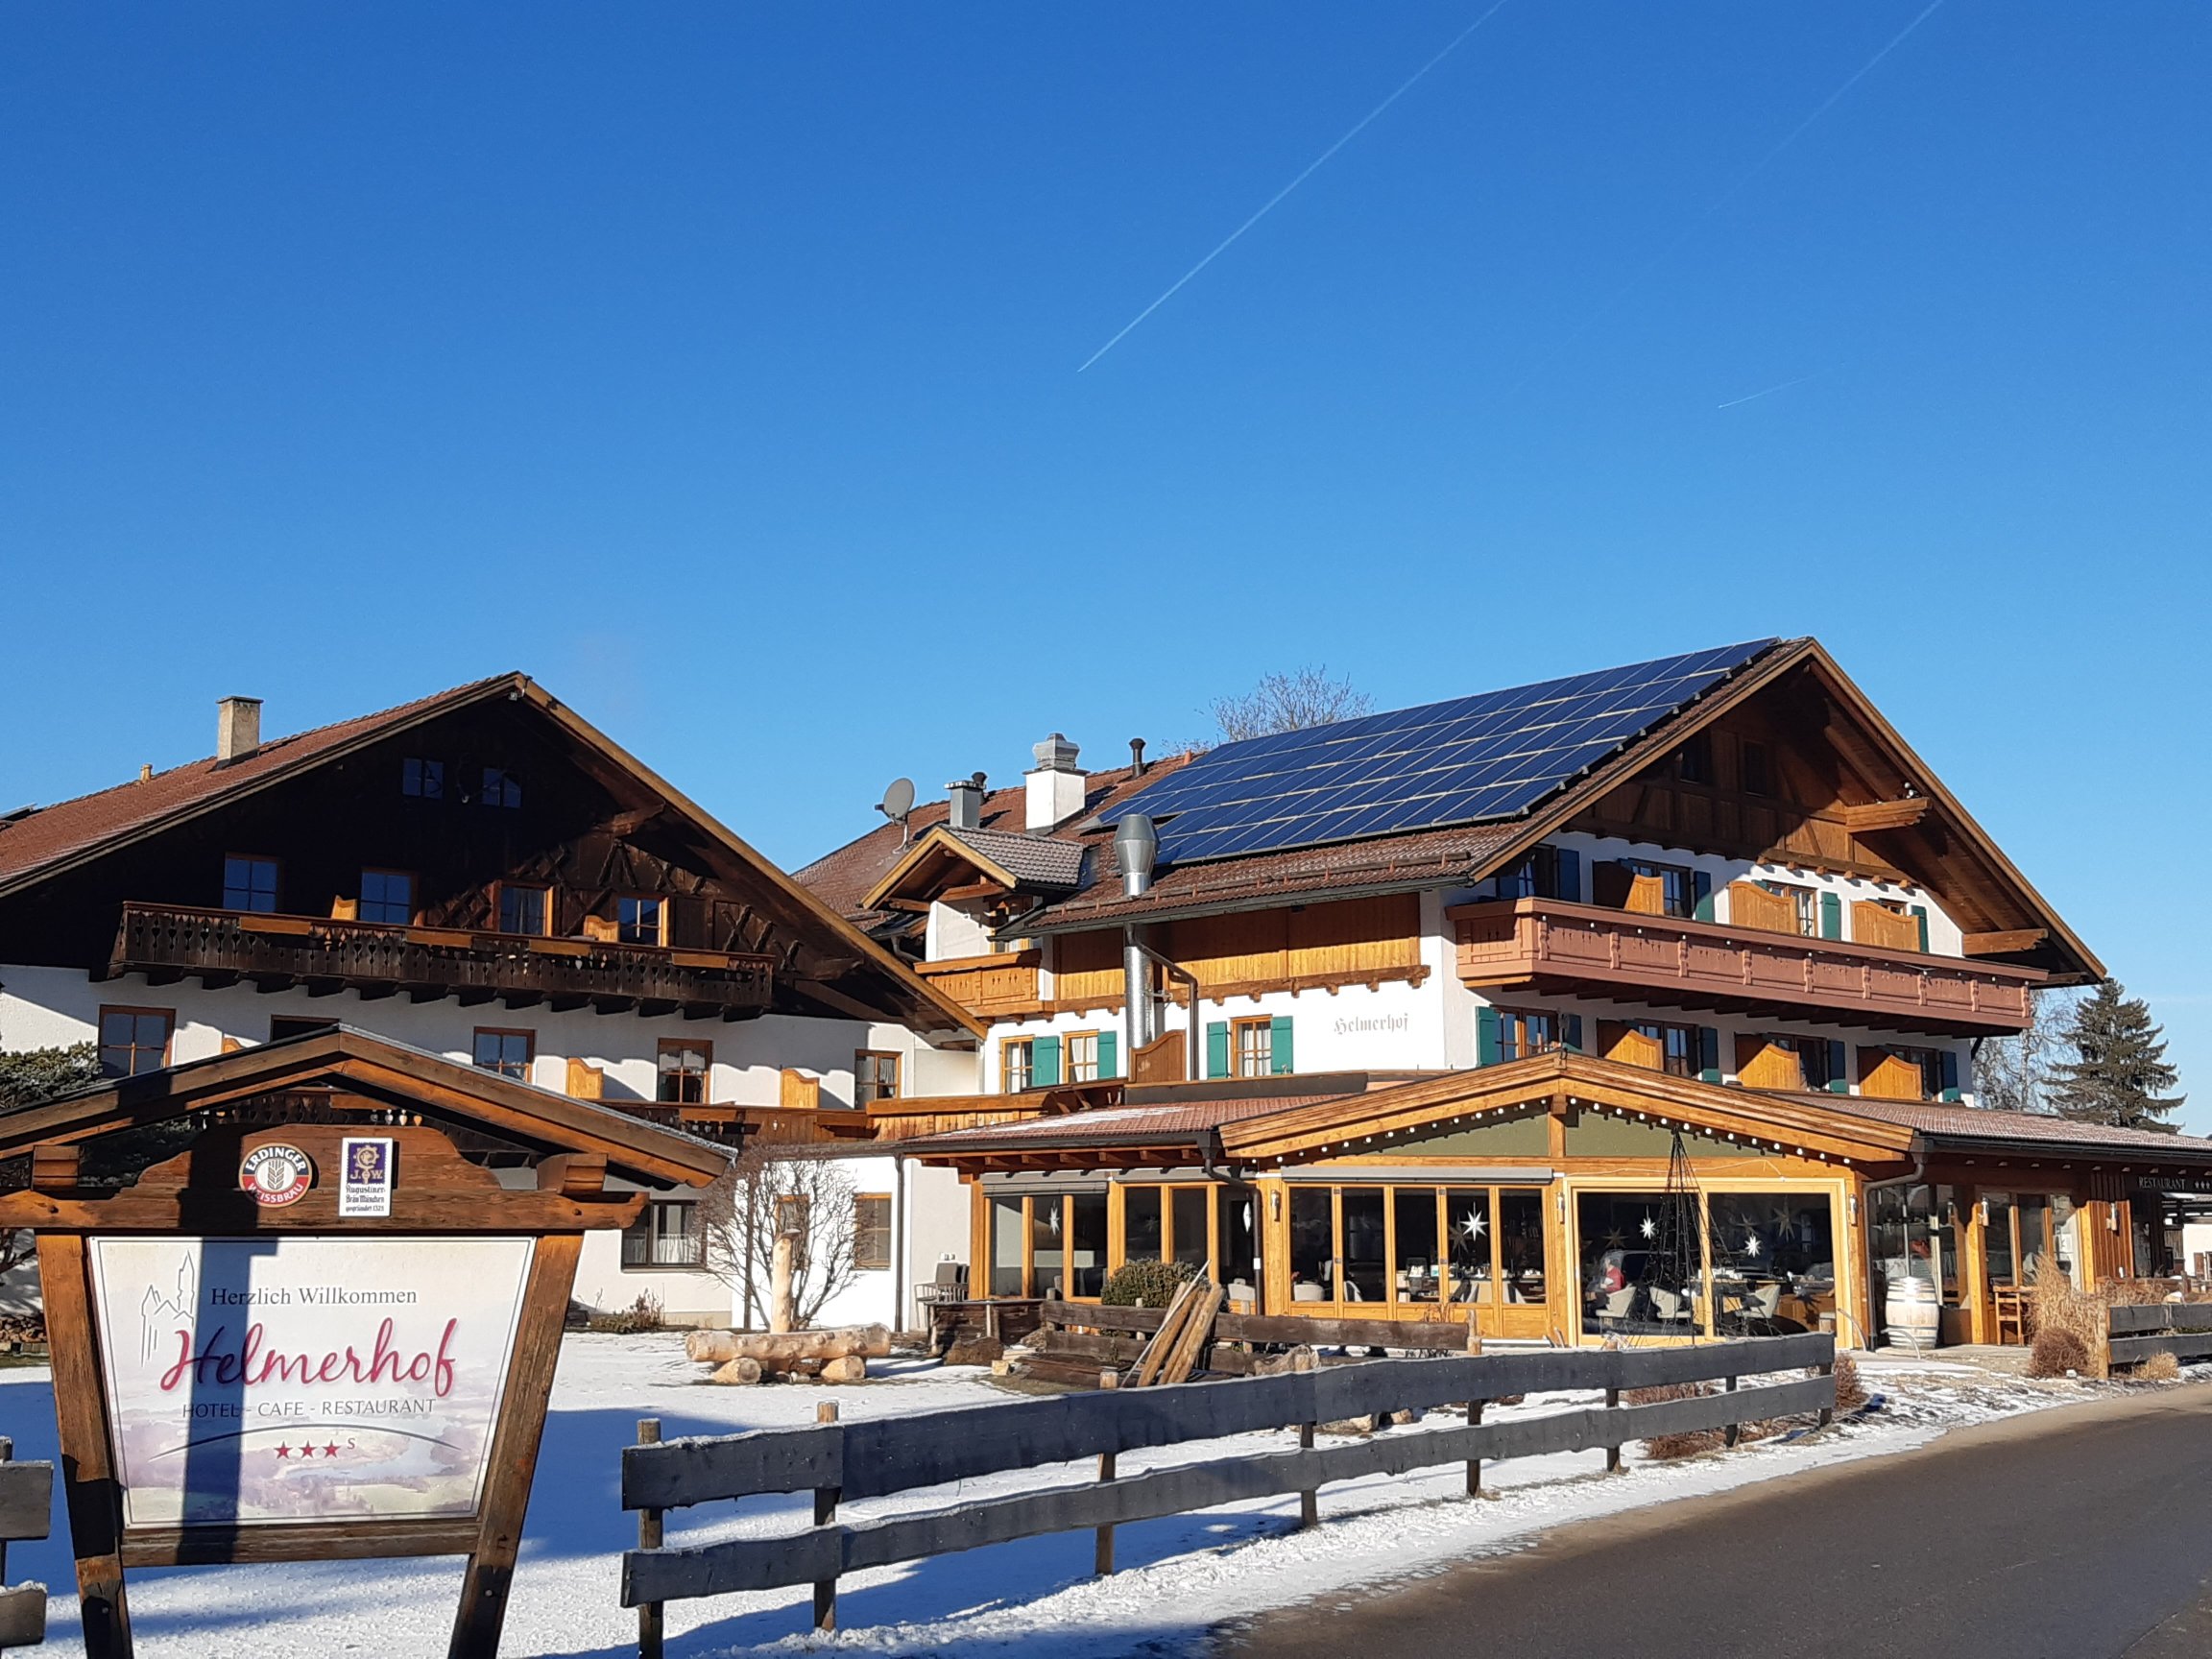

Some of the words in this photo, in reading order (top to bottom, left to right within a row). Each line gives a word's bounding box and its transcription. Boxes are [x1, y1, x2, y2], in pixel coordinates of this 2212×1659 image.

[1334, 1012, 1408, 1035] Helmerhof
[245, 1147, 307, 1171] ERDINGER
[2138, 1176, 2186, 1190] RESTAURANT
[210, 1287, 292, 1306] Herzlich
[298, 1287, 418, 1305] Willkommen
[159, 1317, 459, 1399] Helmerhof
[182, 1403, 241, 1418] HOTEL
[257, 1402, 305, 1416] CAFE
[322, 1398, 437, 1415] RESTAURANT
